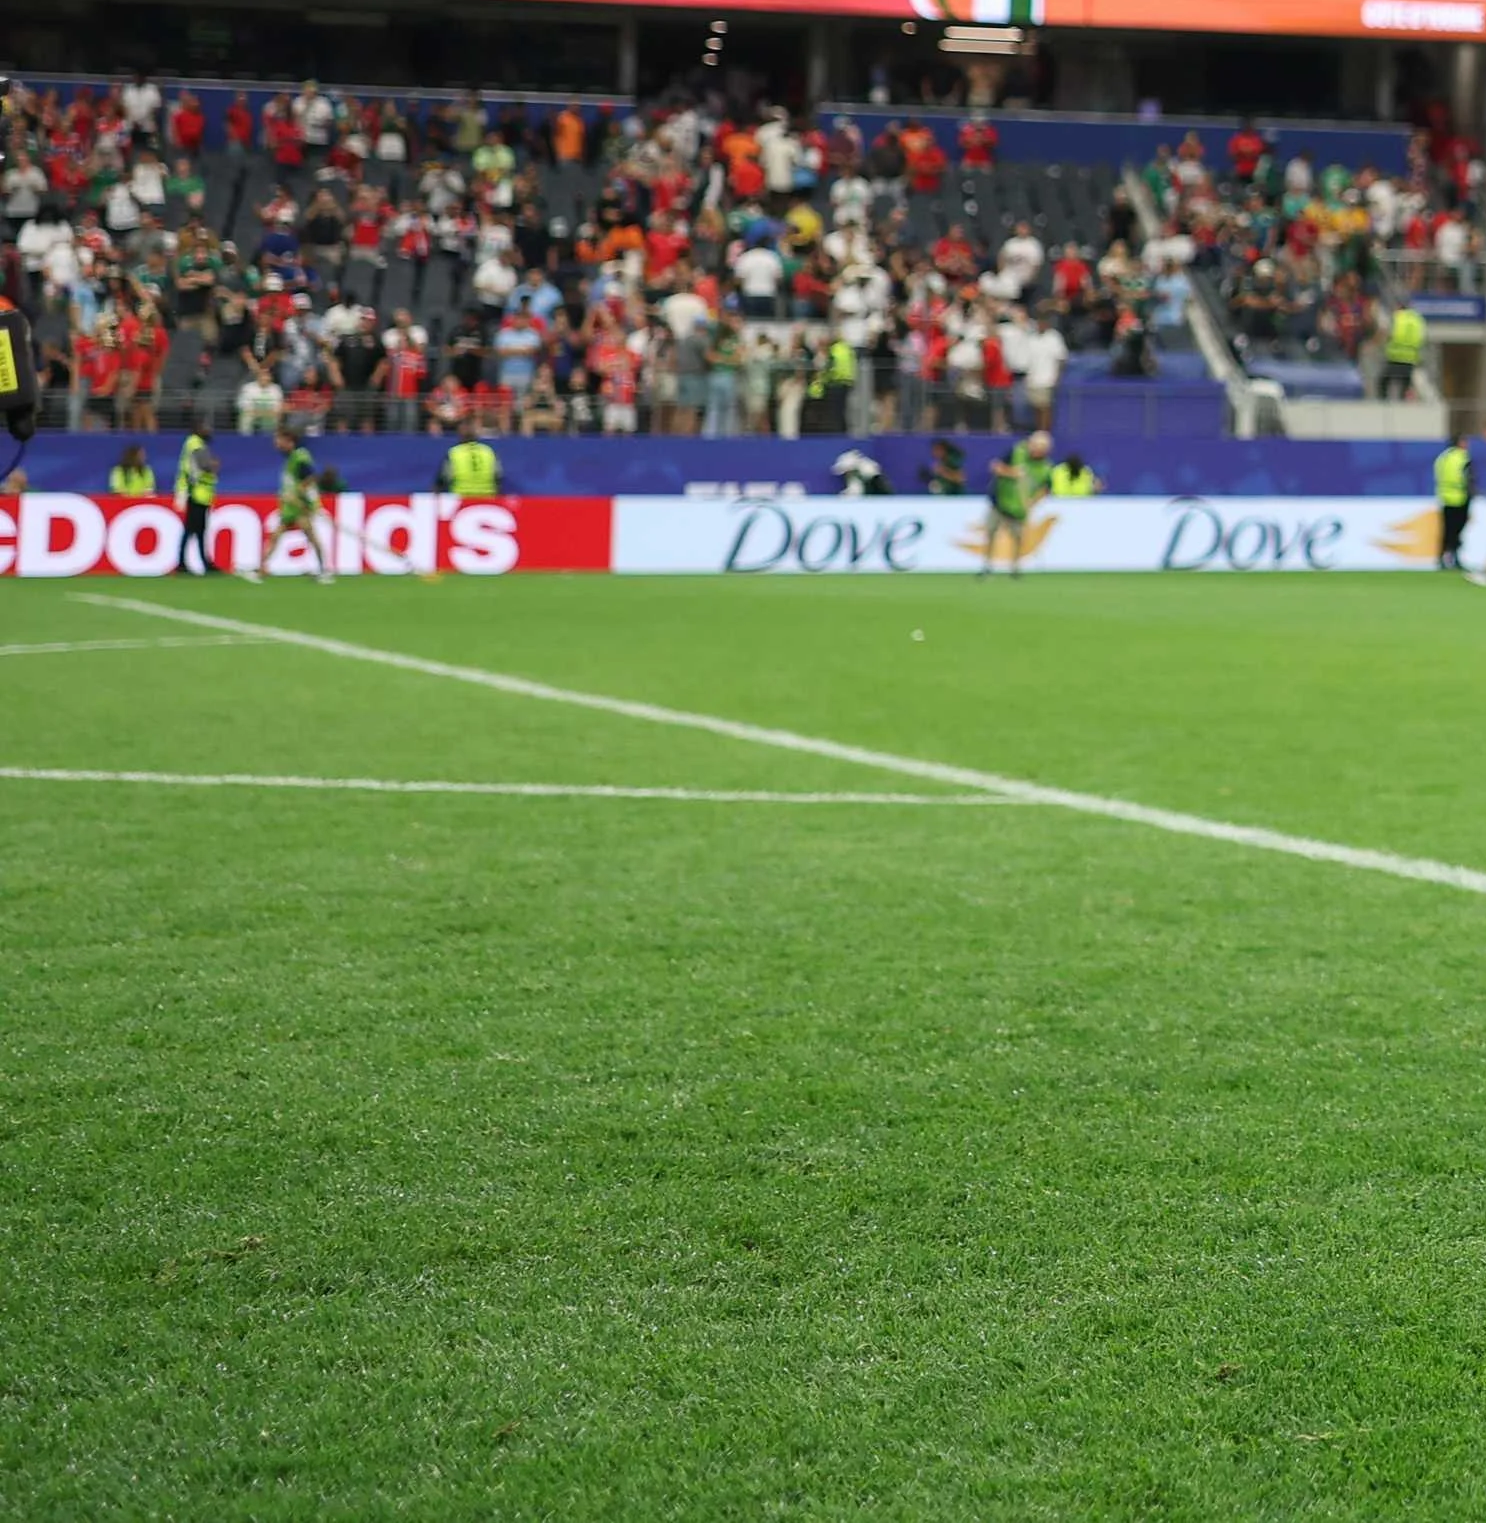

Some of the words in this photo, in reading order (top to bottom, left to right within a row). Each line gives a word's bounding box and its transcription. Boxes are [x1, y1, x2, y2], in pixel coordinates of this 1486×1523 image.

[0, 491, 519, 577] Donald's
[724, 497, 926, 574] Dove
[1160, 494, 1344, 572] Dove
